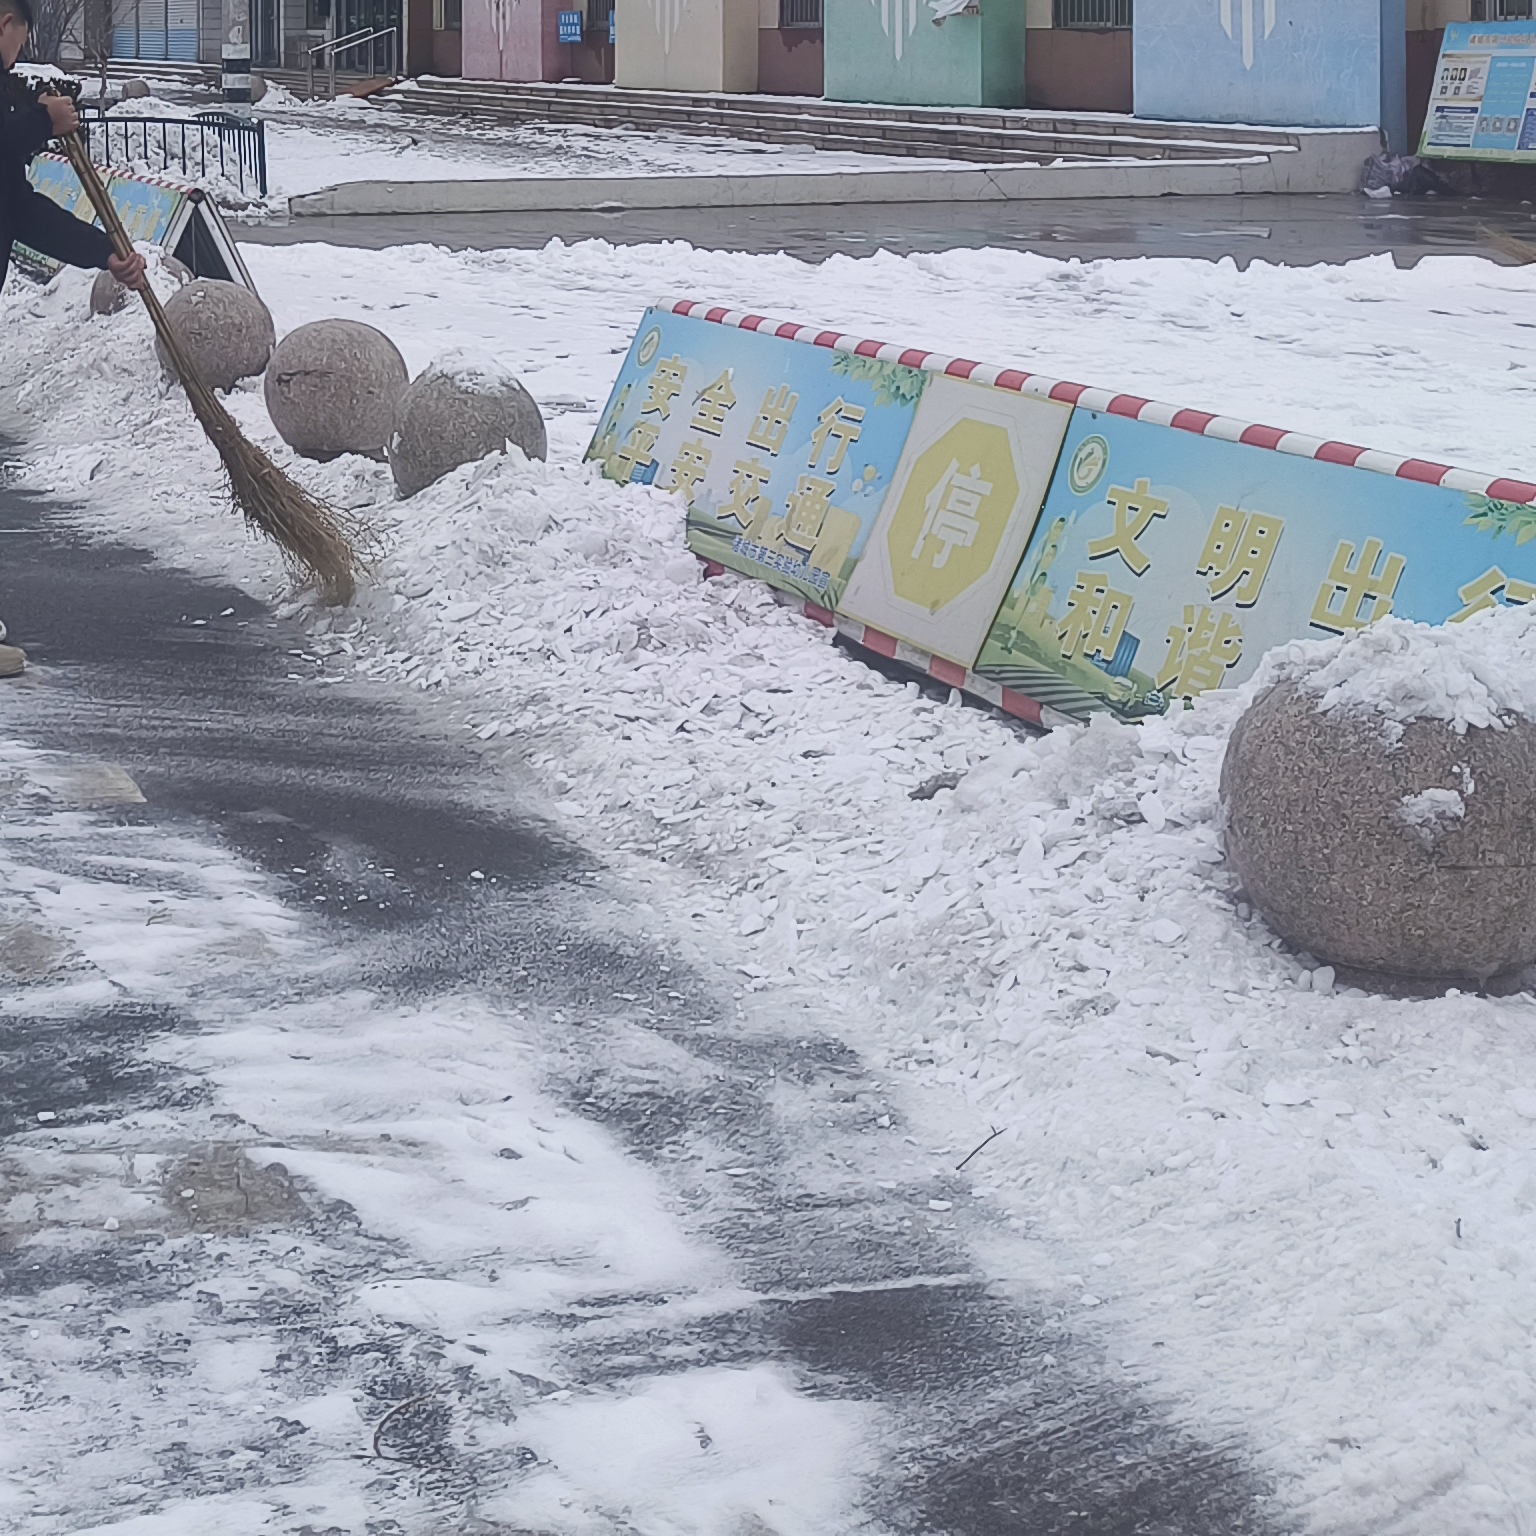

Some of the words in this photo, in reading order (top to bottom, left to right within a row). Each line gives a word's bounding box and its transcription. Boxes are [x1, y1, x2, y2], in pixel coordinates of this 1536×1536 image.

[641, 353, 867, 476] 安全出行
[618, 419, 837, 553] 平安交通
[911, 457, 994, 570] 停
[1057, 570, 1243, 697] 和谐
